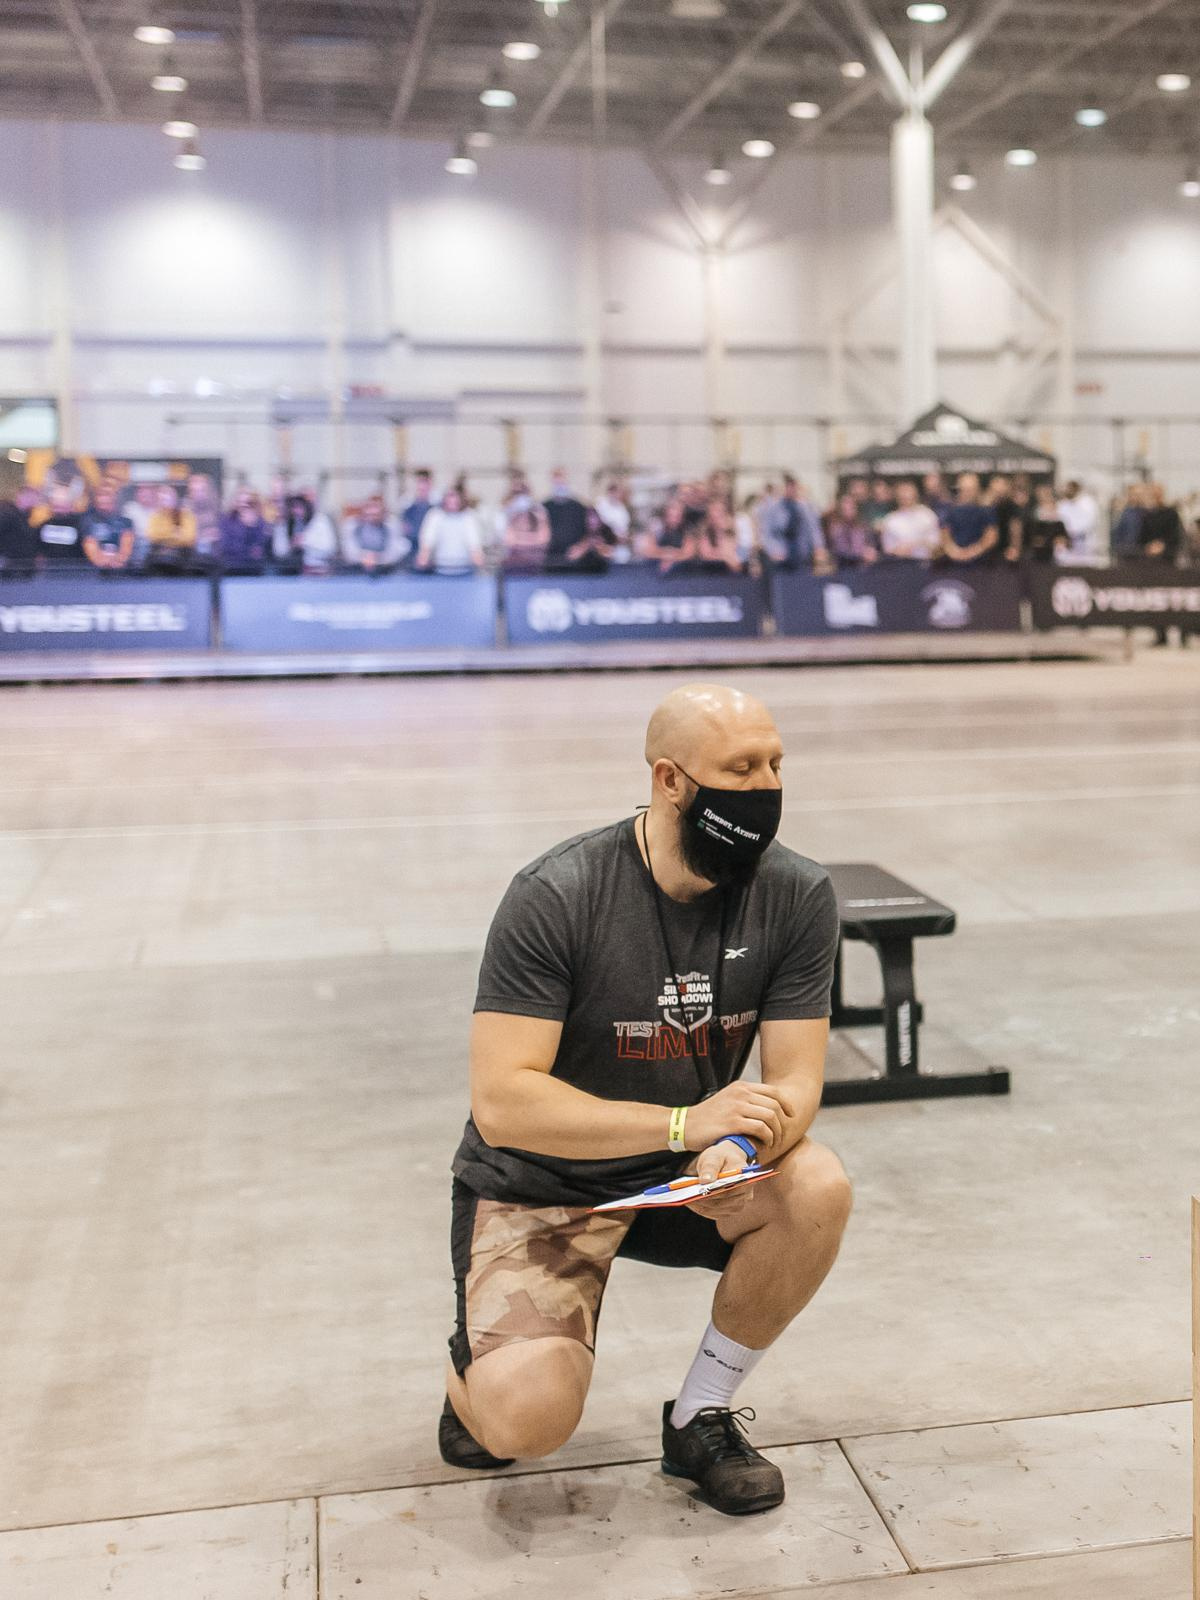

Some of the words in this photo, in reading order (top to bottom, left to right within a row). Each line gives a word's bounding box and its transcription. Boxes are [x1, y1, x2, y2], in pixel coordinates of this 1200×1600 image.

[664, 983, 711, 996] SIRIAN
[613, 1020, 663, 1038] TEST
[616, 1024, 745, 1061] LIMI
